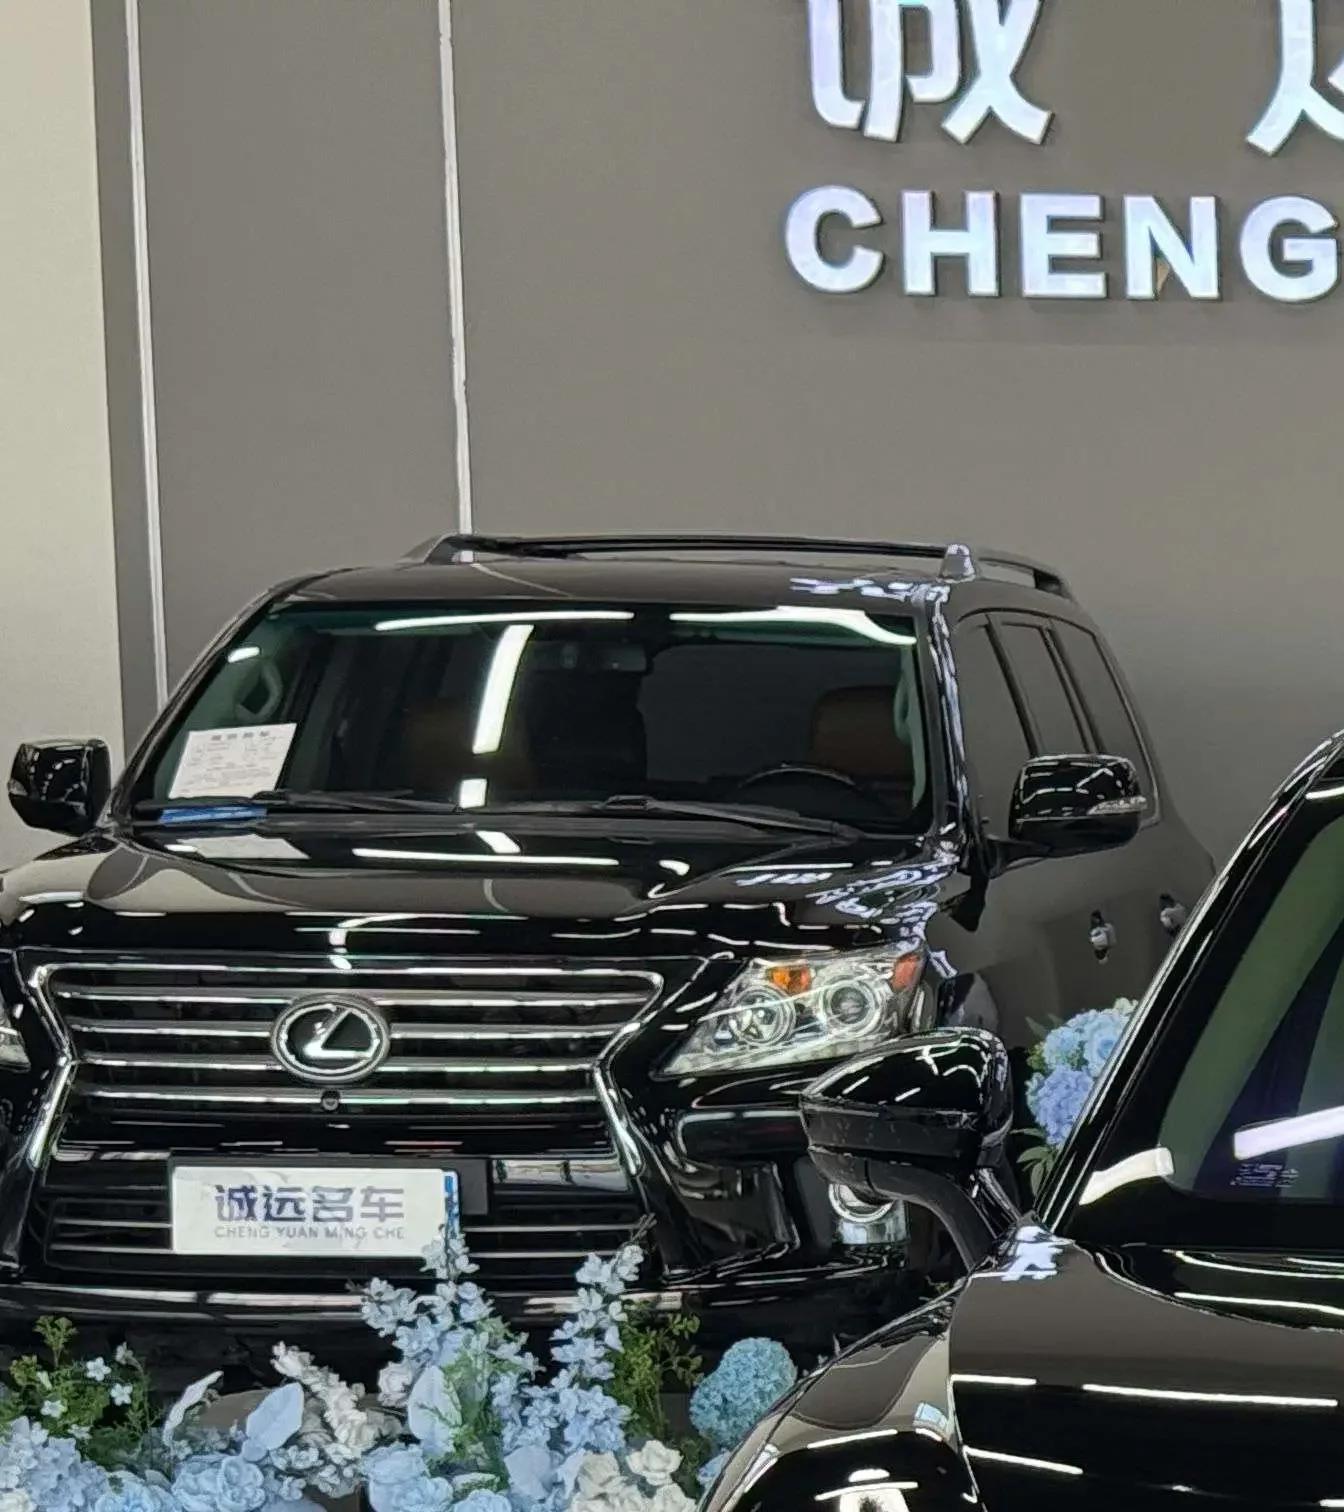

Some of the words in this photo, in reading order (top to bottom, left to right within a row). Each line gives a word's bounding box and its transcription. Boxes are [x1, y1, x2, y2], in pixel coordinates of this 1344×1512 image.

[786, 186, 1338, 302] CHENG
[214, 1184, 405, 1222] 诚远名车
[214, 1226, 270, 1239] CHENG
[277, 1226, 319, 1239] YUAN
[373, 1226, 405, 1240] CHE
